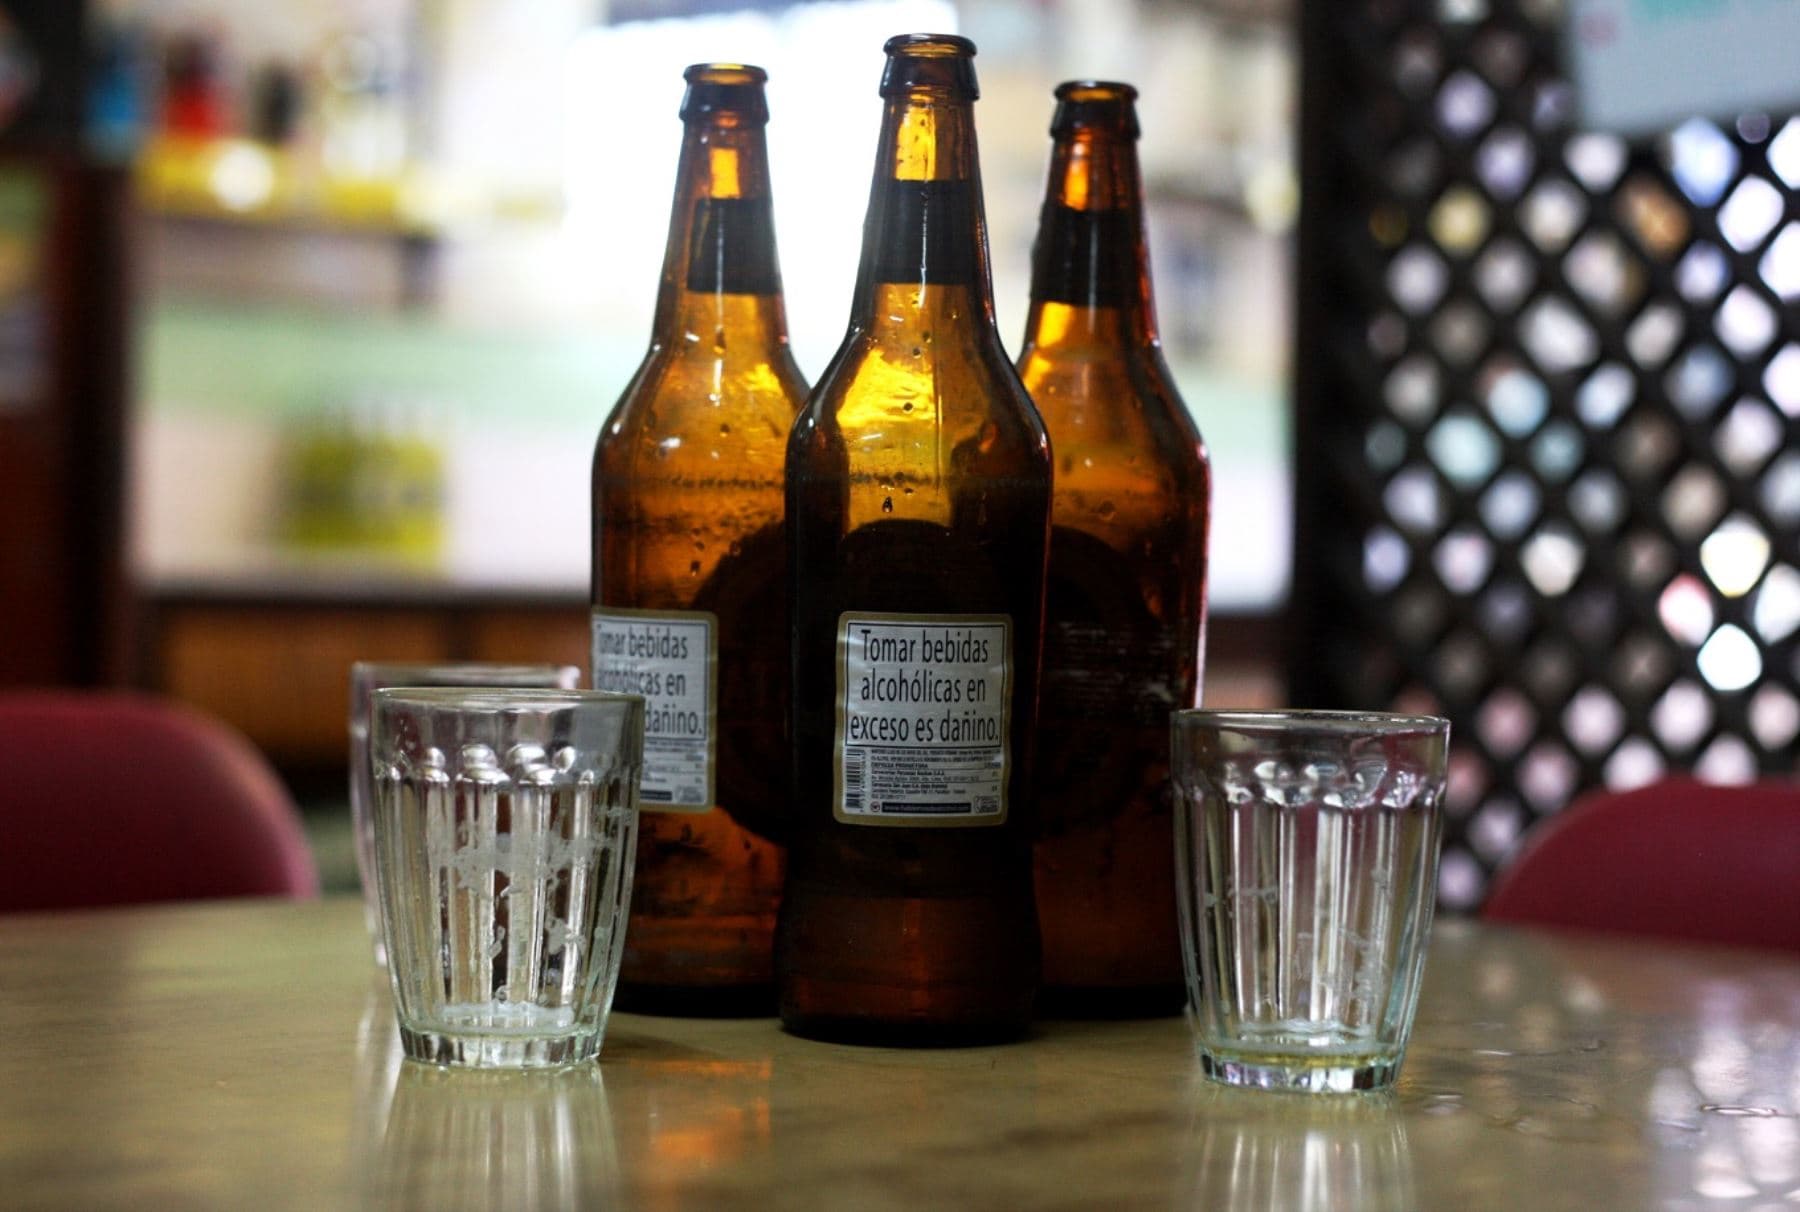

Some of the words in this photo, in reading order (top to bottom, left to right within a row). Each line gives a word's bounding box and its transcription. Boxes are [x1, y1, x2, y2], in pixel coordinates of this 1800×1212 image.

[629, 625, 688, 659] bebidas
[861, 629, 917, 663] Tomar
[921, 630, 988, 663] bebidas
[666, 673, 686, 697] en
[861, 668, 961, 703] alcohólicas
[966, 678, 986, 702] en
[850, 714, 909, 742] exceso
[915, 717, 934, 742] es
[939, 709, 999, 742] dañino.
